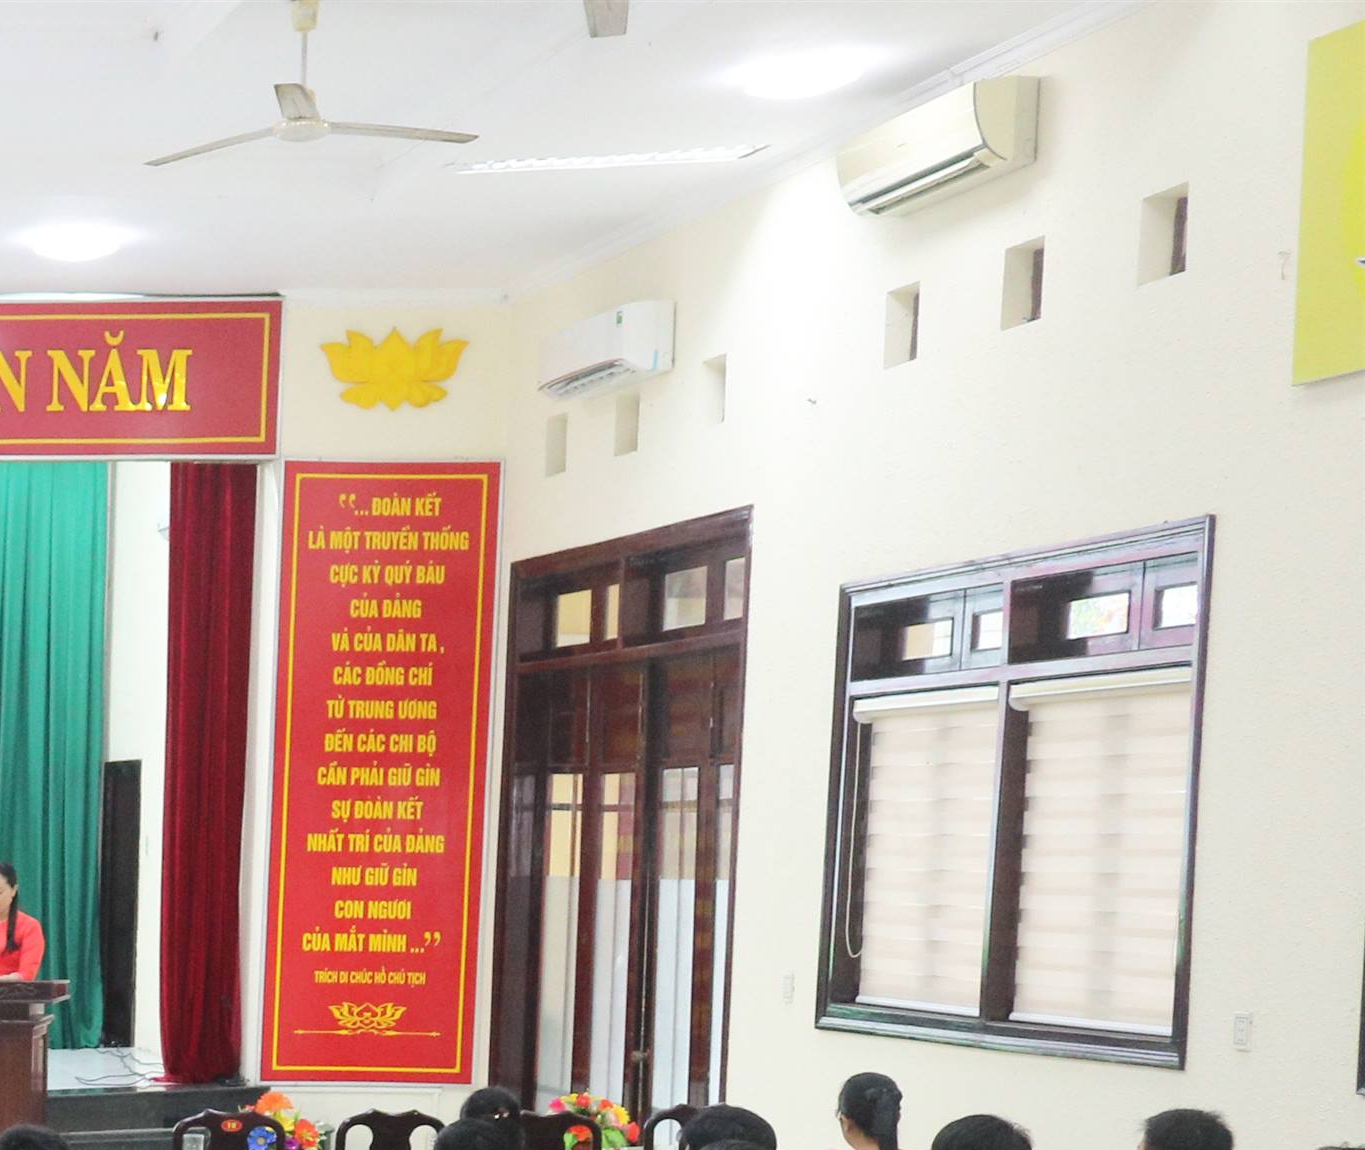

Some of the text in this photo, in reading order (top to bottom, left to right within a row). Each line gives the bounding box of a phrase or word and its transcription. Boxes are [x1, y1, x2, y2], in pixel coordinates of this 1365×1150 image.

[46, 330, 193, 413] NĂM
[420, 634, 437, 651] TA
[348, 700, 394, 719] TRUNG
[390, 734, 413, 752] CHI
[335, 900, 364, 918] CON
